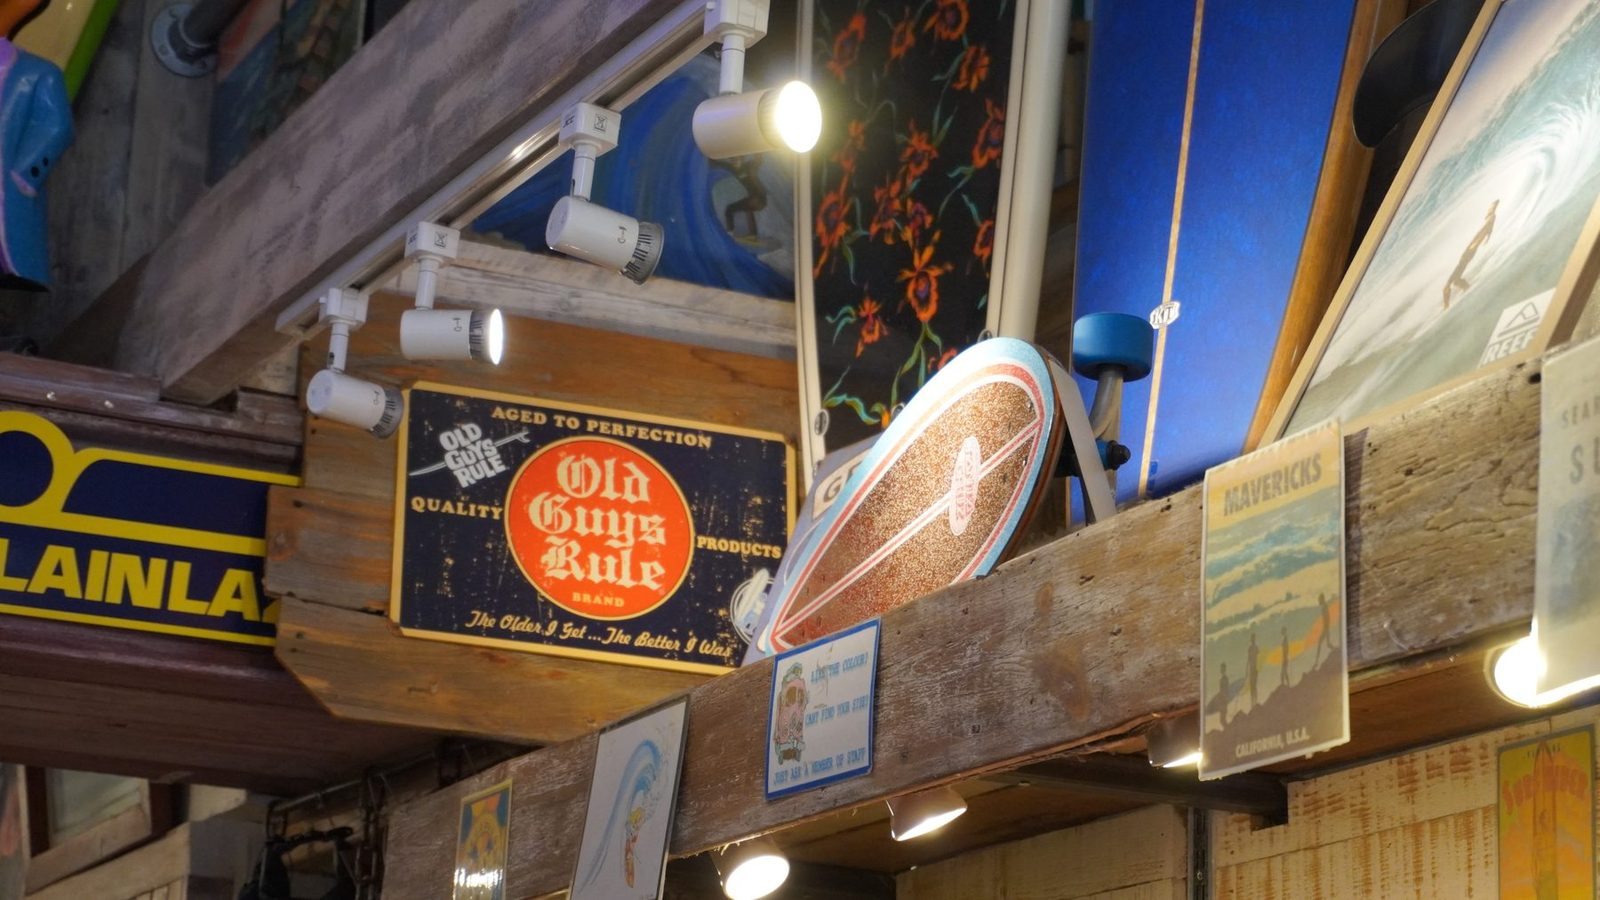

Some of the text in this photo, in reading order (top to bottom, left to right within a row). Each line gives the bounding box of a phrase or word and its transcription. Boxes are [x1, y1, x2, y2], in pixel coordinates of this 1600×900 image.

[1483, 329, 1537, 365] REEF
[439, 423, 482, 452] OLD
[491, 406, 712, 449] AGED TO PERFECTION
[444, 438, 498, 471] GUYS
[453, 454, 507, 488] RULE
[556, 454, 650, 504] Old
[1223, 453, 1322, 517] MAVERICKS
[411, 496, 504, 520] QUALITY
[528, 491, 667, 549] Guys
[540, 535, 666, 590] Rule
[697, 535, 782, 559] PRODUCTS
[0, 538, 282, 622] LAINLA
[572, 591, 625, 607] BRAND
[465, 610, 496, 628] The
[499, 614, 542, 633] Older
[545, 620, 558, 636] I
[634, 631, 681, 651] Better
[684, 635, 697, 653] I
[699, 639, 733, 657] Was
